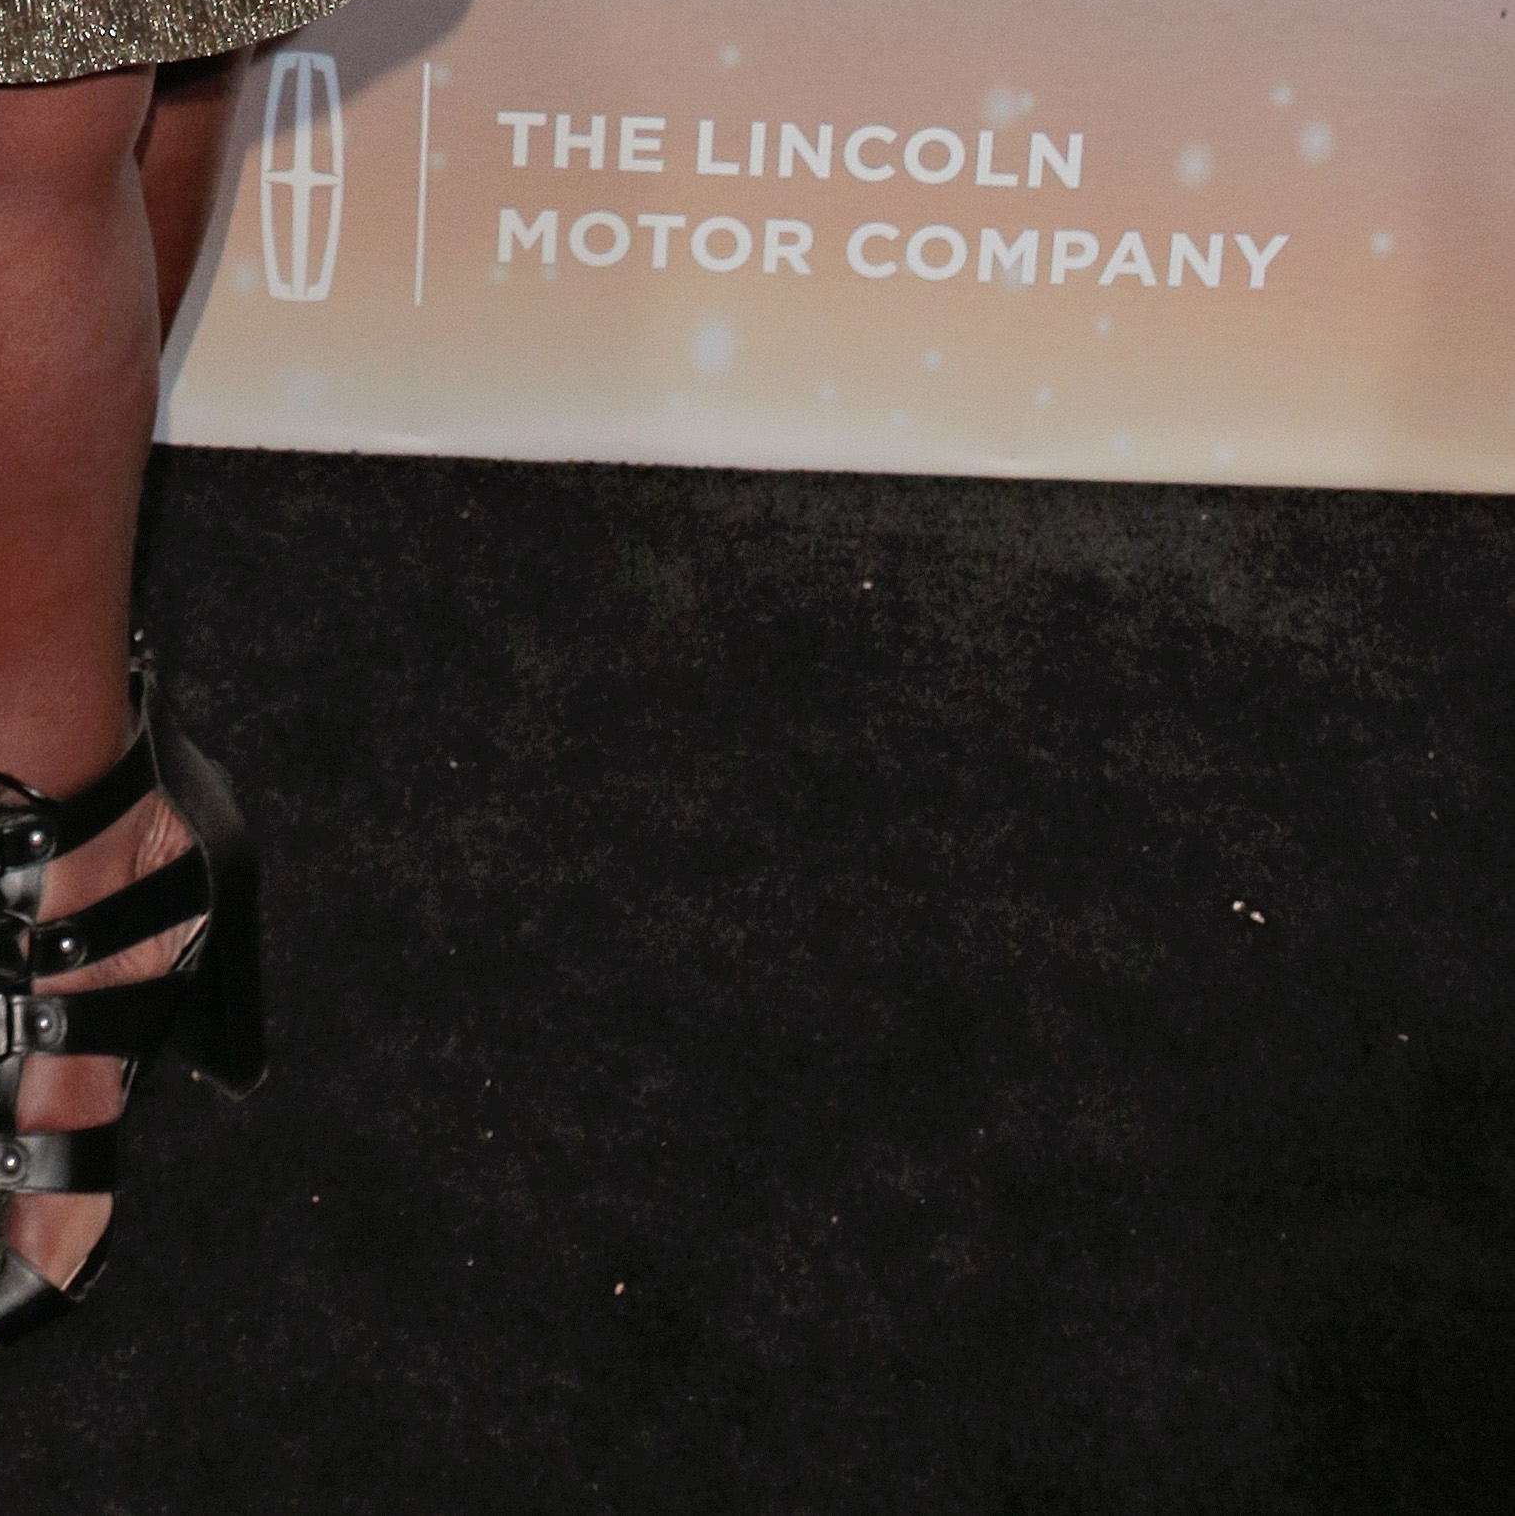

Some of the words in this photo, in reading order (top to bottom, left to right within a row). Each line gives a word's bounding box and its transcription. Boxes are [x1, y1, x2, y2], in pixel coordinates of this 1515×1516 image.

[496, 111, 667, 173] THE
[695, 120, 1085, 189] LINCOLN
[495, 208, 812, 275] MOTOR
[844, 223, 1289, 290] COMPANY
